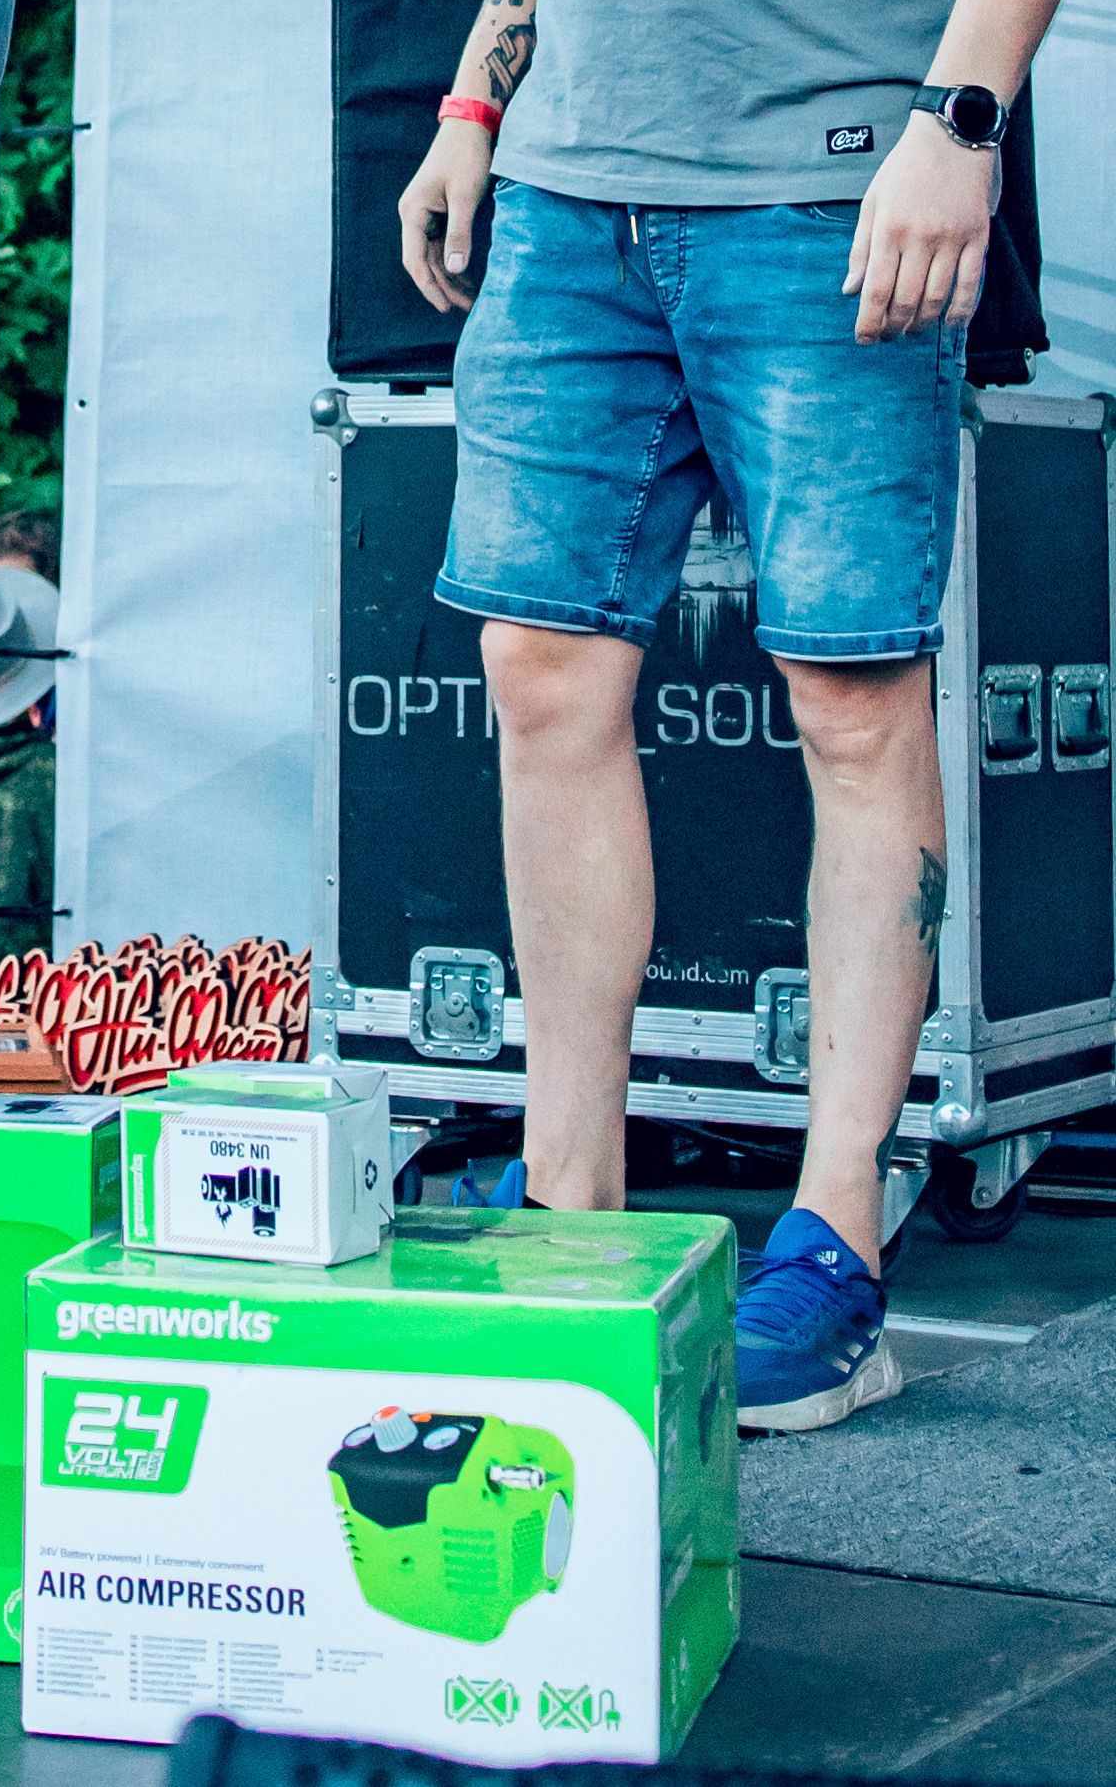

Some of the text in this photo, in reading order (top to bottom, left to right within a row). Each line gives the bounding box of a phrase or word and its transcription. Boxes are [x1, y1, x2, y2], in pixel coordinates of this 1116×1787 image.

[210, 1140, 270, 1160] UN 3480
[56, 1300, 273, 1343] greenworks
[66, 1392, 179, 1450] 24
[64, 1445, 148, 1468] VOLT
[40, 1546, 264, 1573] 24V Battery powered Extremely convenient
[37, 1570, 306, 1617] AIR COMPRESSOR
